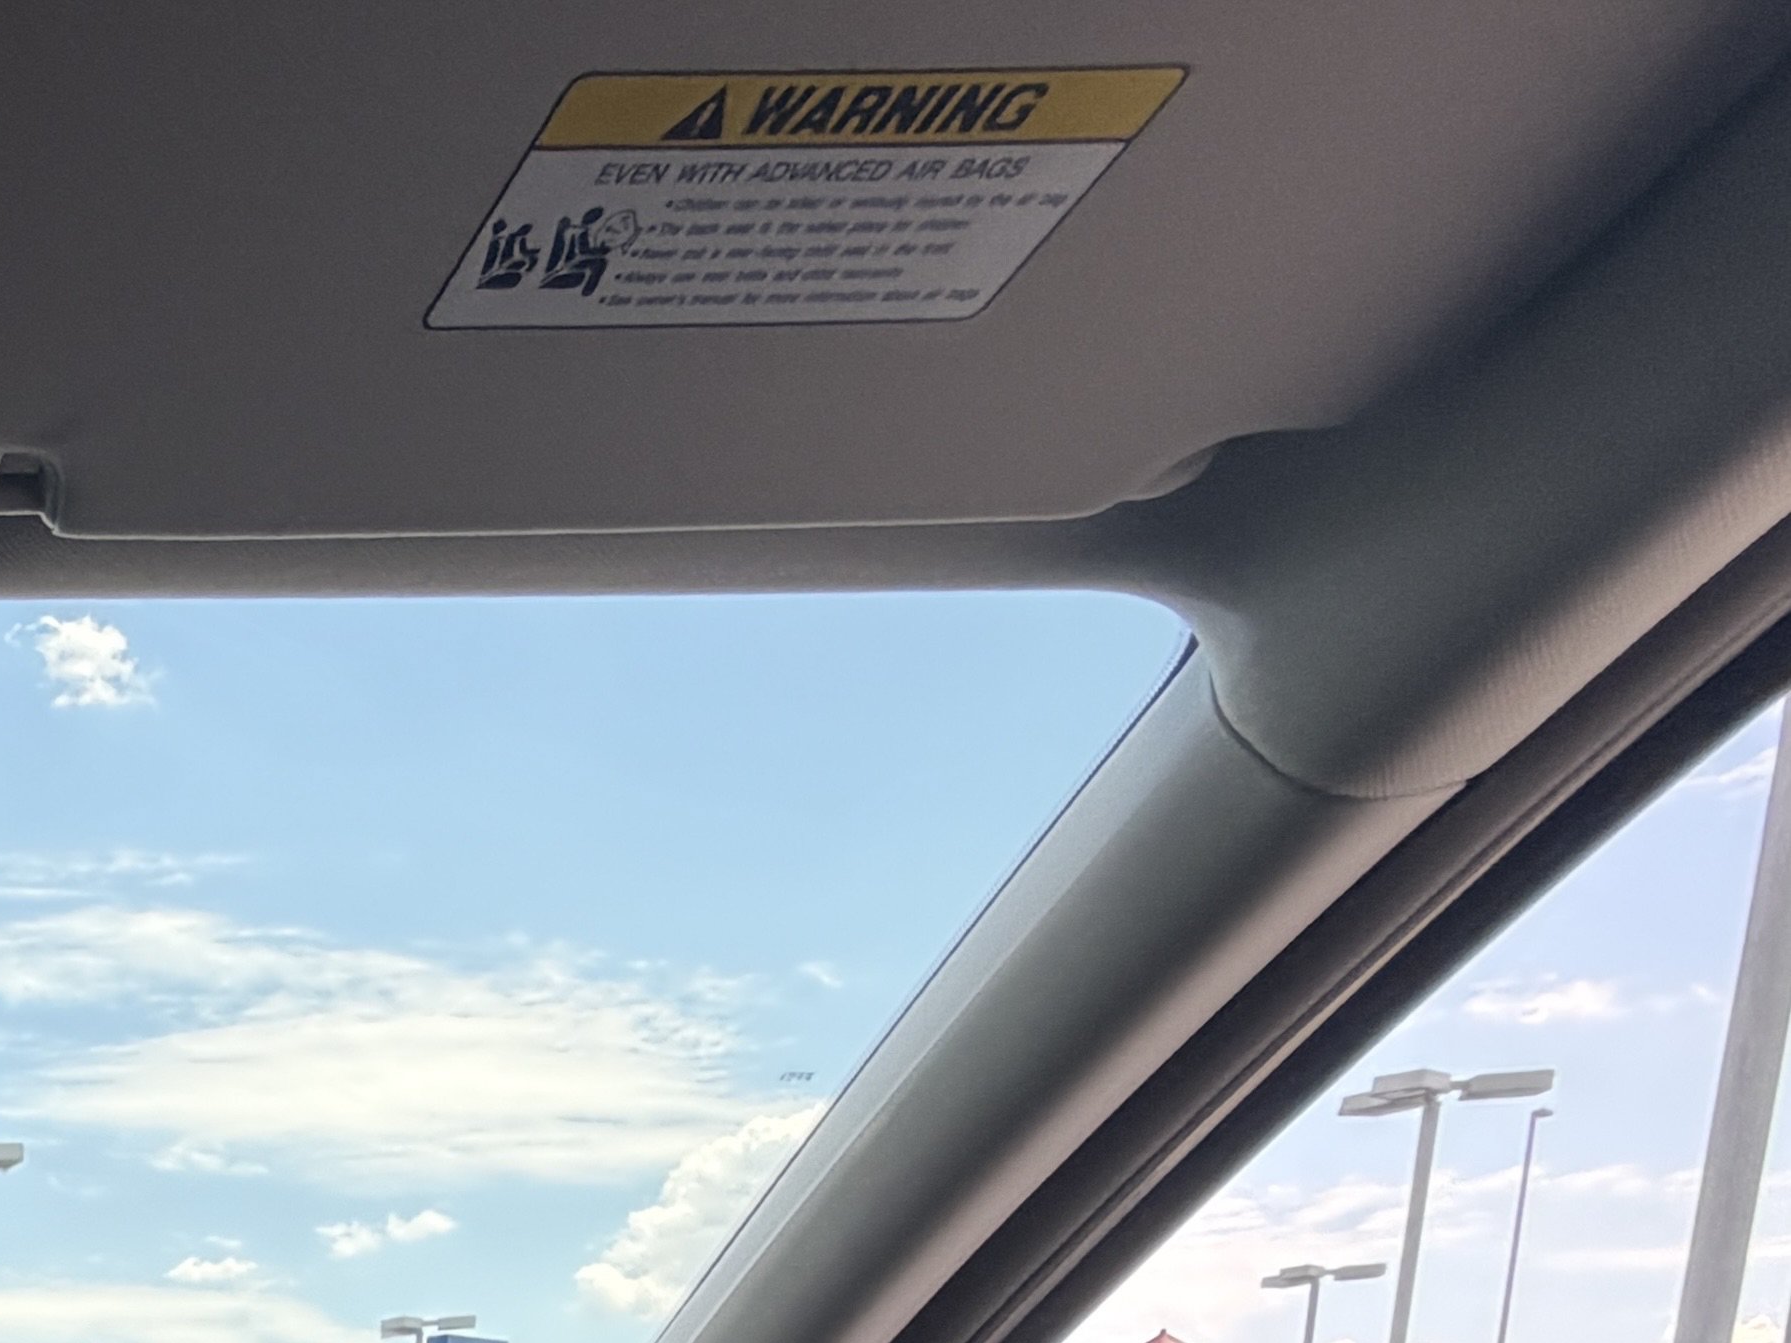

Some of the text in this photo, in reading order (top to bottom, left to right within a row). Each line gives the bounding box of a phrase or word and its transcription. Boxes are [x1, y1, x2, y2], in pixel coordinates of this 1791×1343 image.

[744, 83, 1050, 137] WARNING
[595, 156, 1030, 187] EVEN WITH ADVANCED AIR BAGS
